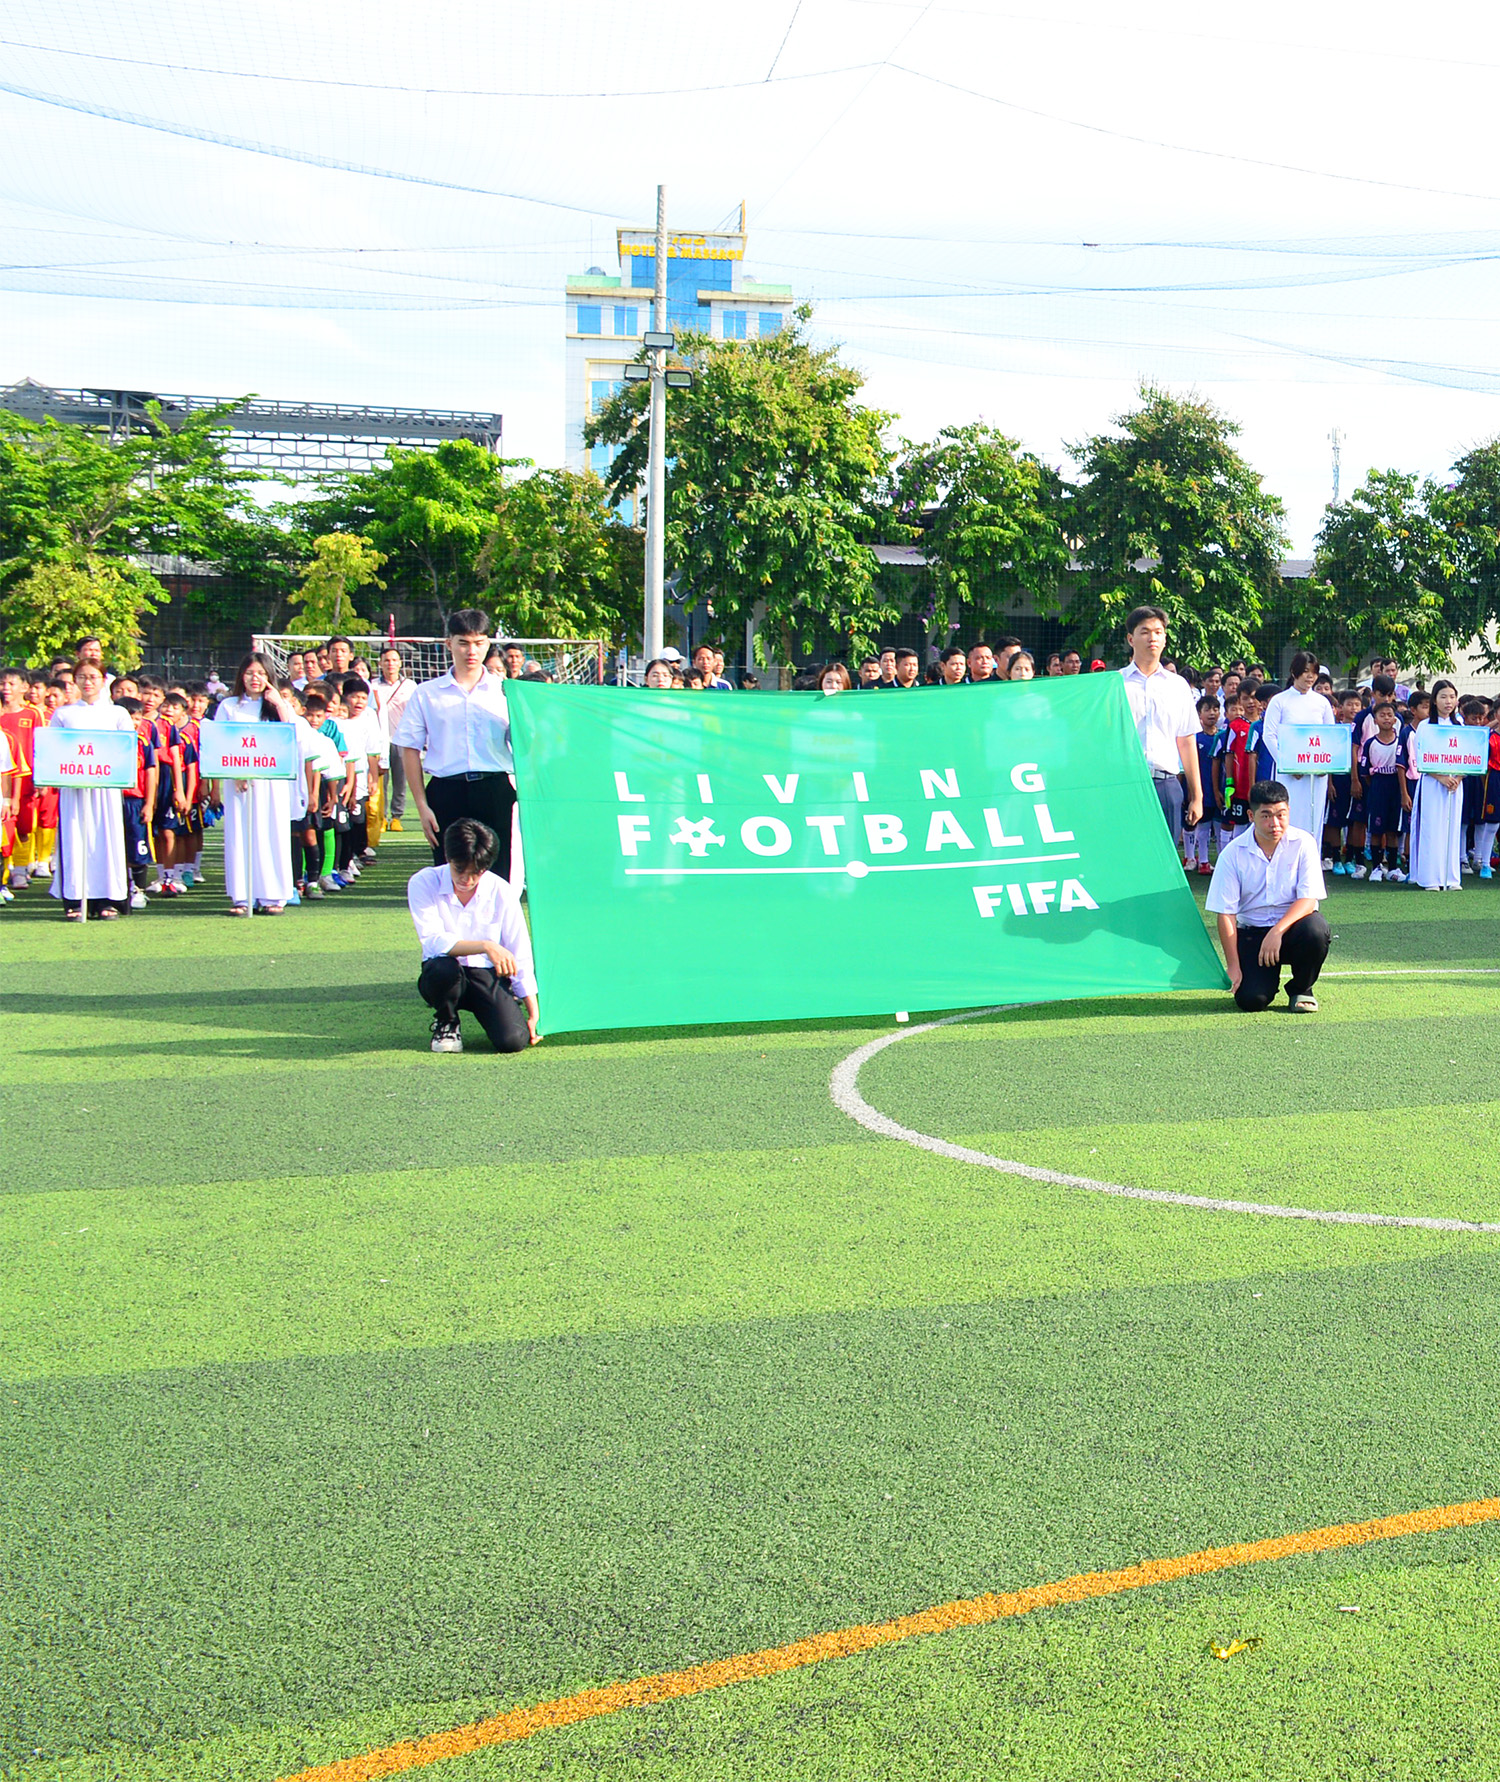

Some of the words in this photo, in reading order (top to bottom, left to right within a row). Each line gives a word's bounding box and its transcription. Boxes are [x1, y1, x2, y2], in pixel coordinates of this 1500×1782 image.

[620, 244, 656, 257] HOTE
[680, 247, 744, 261] MASSAGE
[78, 742, 94, 756] XÃ
[241, 736, 257, 749] XÃ
[1308, 736, 1321, 747] XÃ
[1448, 736, 1458, 748] XÃ
[221, 753, 250, 768] BÌNH
[253, 753, 277, 768] HÒA
[1297, 752, 1311, 764] MỸ
[1314, 752, 1332, 764] ĐỨC
[1423, 751, 1439, 763] BÌNH
[1441, 754, 1462, 766] THẠNH
[60, 762, 87, 776] HÒA
[88, 764, 112, 779] LẠC
[613, 763, 1047, 804] LIVING
[137, 840, 148, 856] 6
[972, 878, 1101, 918] FIFA
